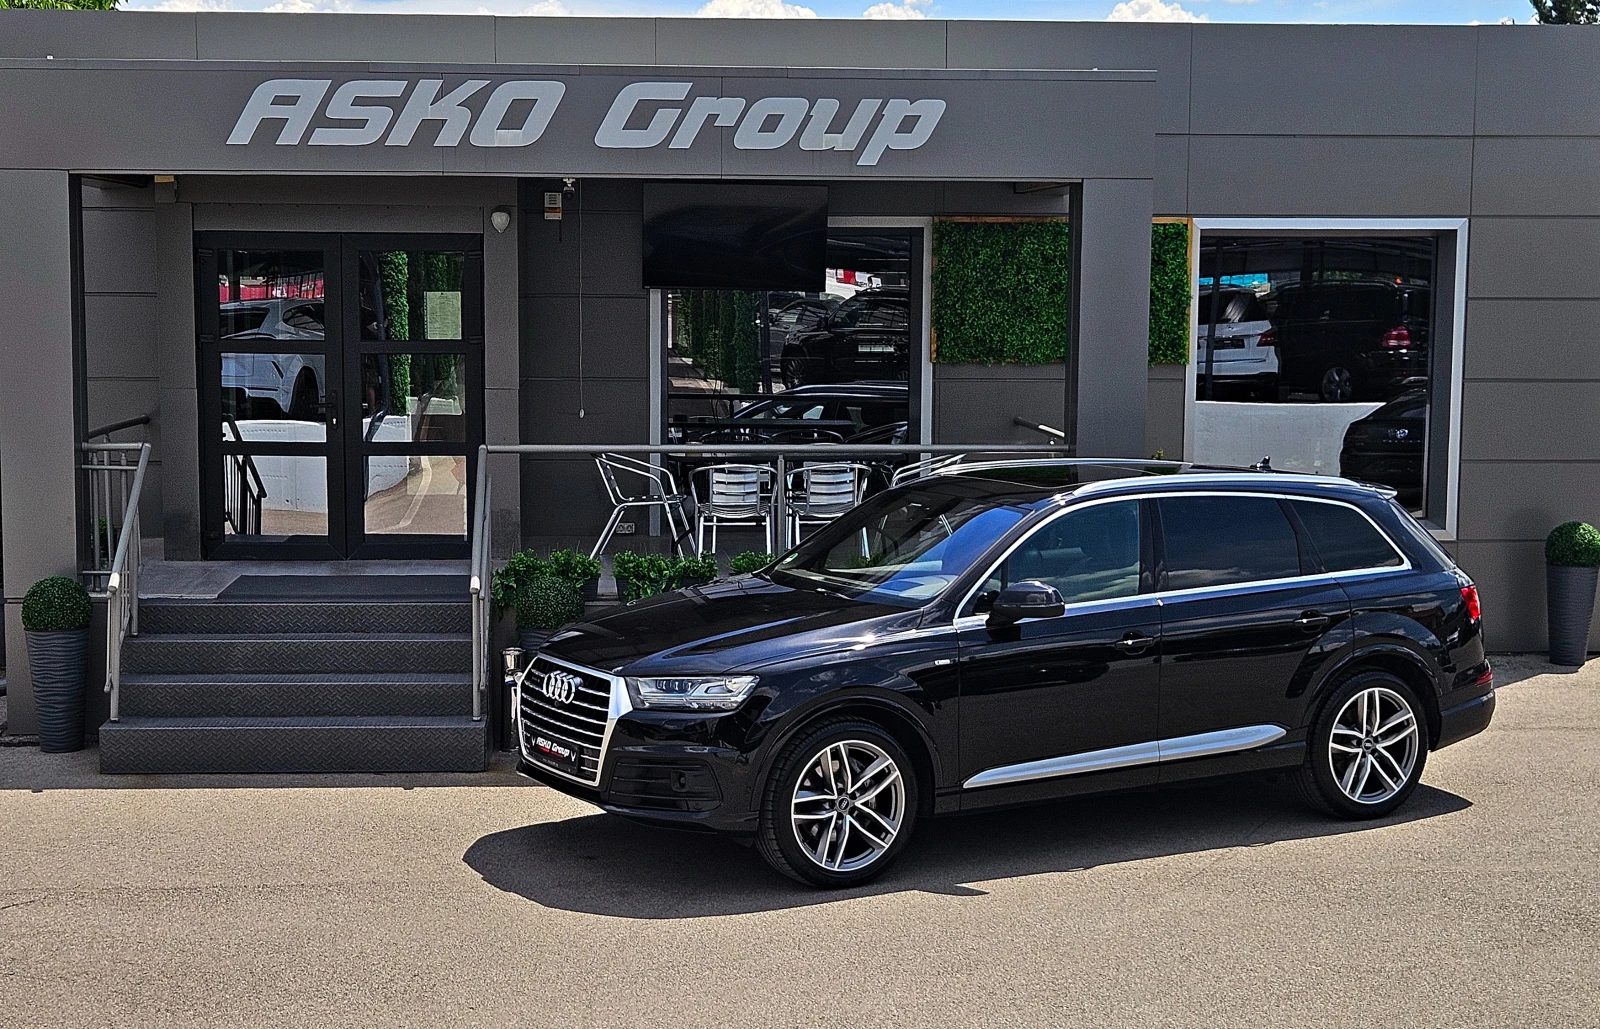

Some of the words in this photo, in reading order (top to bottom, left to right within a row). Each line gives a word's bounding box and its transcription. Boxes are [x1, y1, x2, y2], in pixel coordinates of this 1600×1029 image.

[225, 79, 567, 148] ASKO
[594, 81, 947, 166] Group
[536, 737, 552, 749] ASKO
[552, 743, 570, 757] Group
